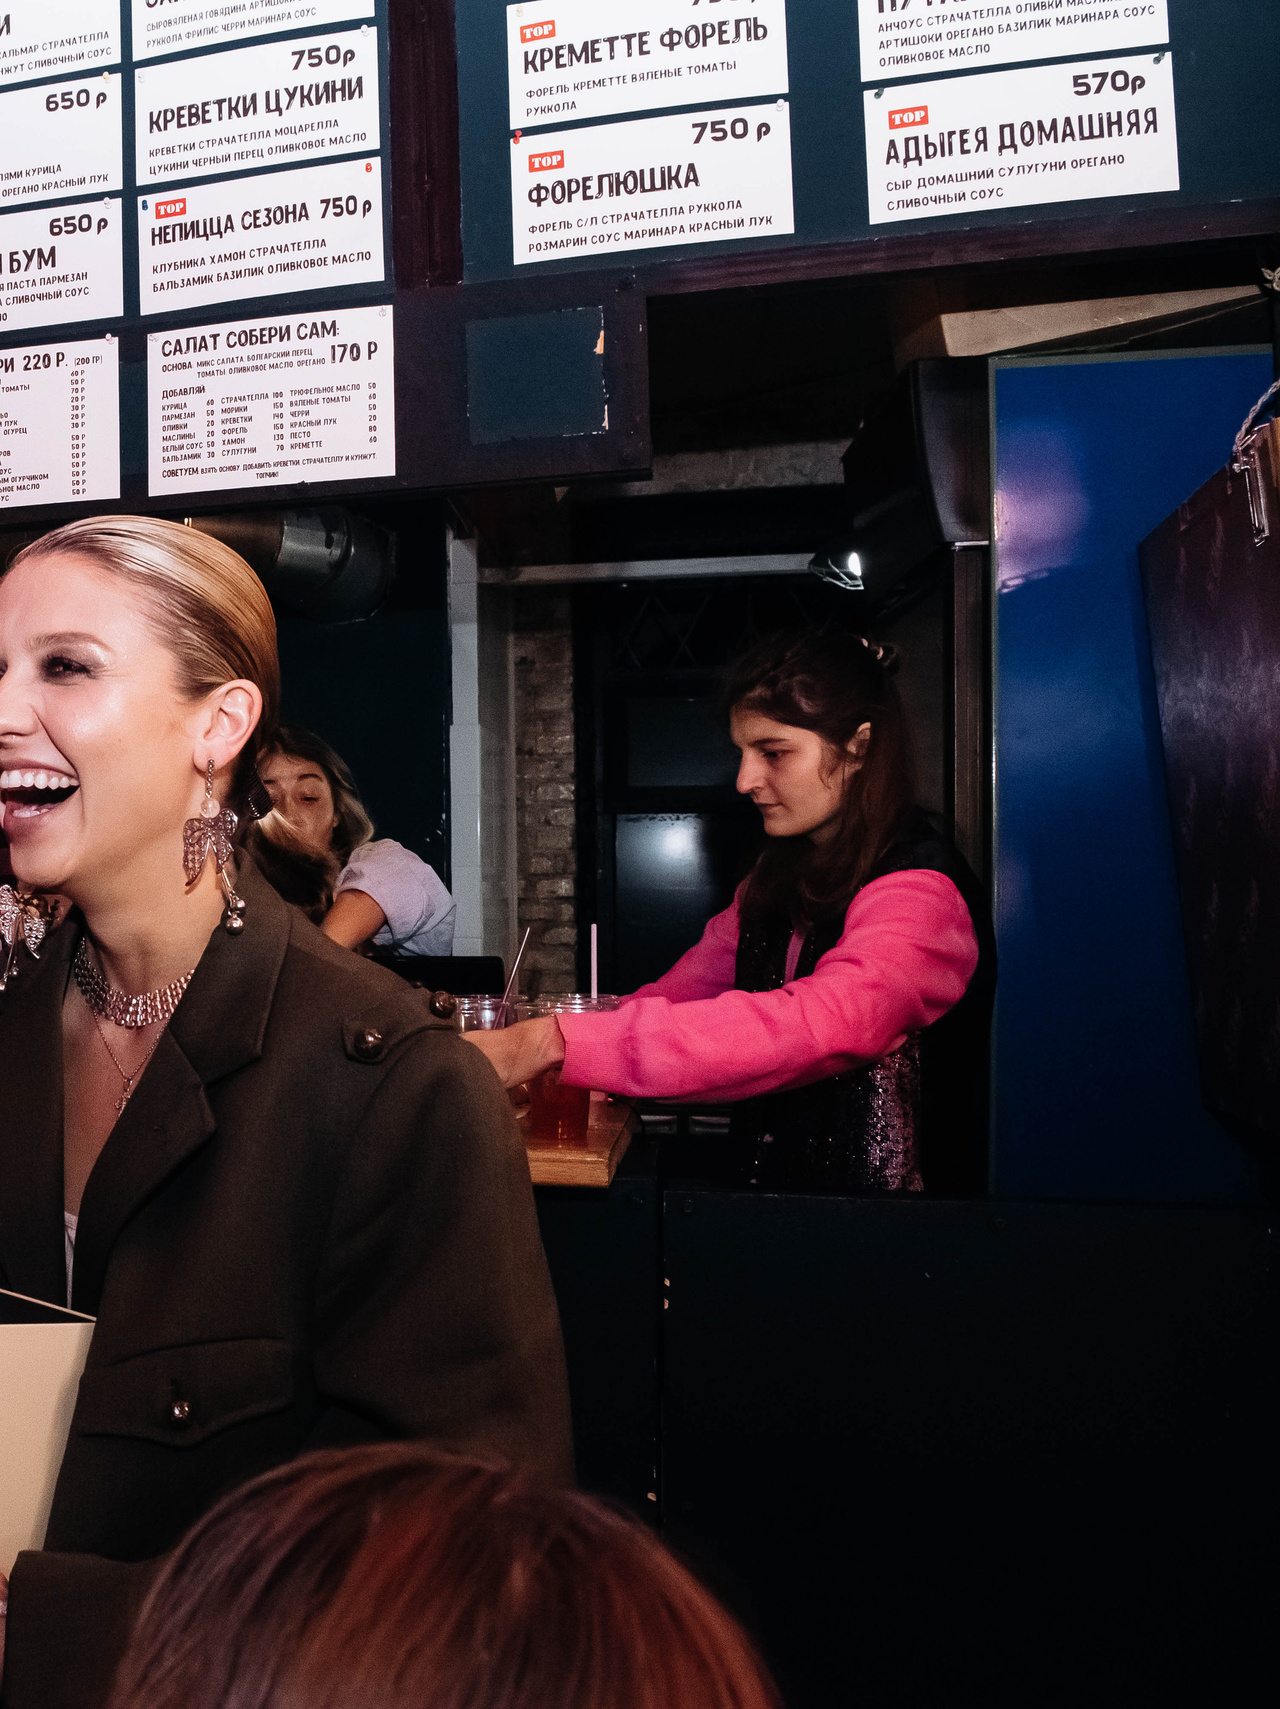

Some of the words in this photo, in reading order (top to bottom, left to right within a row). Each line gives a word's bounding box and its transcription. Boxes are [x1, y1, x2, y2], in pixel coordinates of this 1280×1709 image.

[523, 24, 553, 39] TOP
[524, 32, 650, 74] КРЕМЕТТЕ
[660, 17, 767, 51] ФОРЕЛЬ
[526, 85, 569, 98] ФОРЕЛЬ
[574, 75, 627, 91] КРЕМЕТТЕ
[631, 68, 682, 82] ВЯЛЕНЫЕ
[687, 61, 736, 74] ТОМАТЫ
[150, 93, 257, 133] КРЕВЕТКИ
[265, 76, 363, 116] ЦУКИНИ
[527, 101, 576, 117] РУККОЛА
[892, 110, 925, 125] TOP
[149, 142, 195, 157] КРЕВЕТКИ
[199, 130, 271, 149] СТРАЧАТЕЛЛА
[275, 119, 338, 136] МОЦАРЕЛЛА
[150, 160, 189, 175] ЦУКИНИ
[234, 149, 264, 161] ПЕРЕЦ
[268, 139, 325, 155] ОЛИВКОВОЕ
[329, 133, 366, 145] МАСЛО
[886, 127, 988, 168] АДЫГЕЯ
[998, 107, 1157, 156] ДОМАШНЯЯ
[532, 155, 561, 168] TOP
[887, 180, 912, 191] СЫР
[917, 169, 994, 189] ДОМАШНИЙ
[999, 161, 1066, 177] СУЛУГУНИ
[1071, 155, 1124, 169] ОРЕГАНО
[528, 163, 700, 207] ФОРЕЛЮШКА
[151, 214, 234, 246] НЕПИЦЦА
[241, 202, 309, 230] СЕЗОНА
[320, 195, 357, 218] 750
[158, 202, 184, 215] TOP
[529, 237, 587, 252] РОЗМАРИН
[591, 232, 620, 244] СОУС
[689, 218, 744, 232] КРАСНЫЙ
[749, 216, 772, 226] ЛУК
[9, 246, 56, 273] БУМ
[153, 257, 205, 274] КЛУБНИКА
[210, 250, 245, 264] ХАМОН
[249, 239, 326, 258] СТРАЧАТЕЛЛА
[7, 279, 36, 290] ПАСТА
[40, 272, 87, 286] ПАРМЕЗАН
[162, 333, 220, 357] САЛАТ
[226, 325, 290, 348] СОБЕРИ
[331, 343, 360, 363] 170
[23, 353, 51, 371] 220
